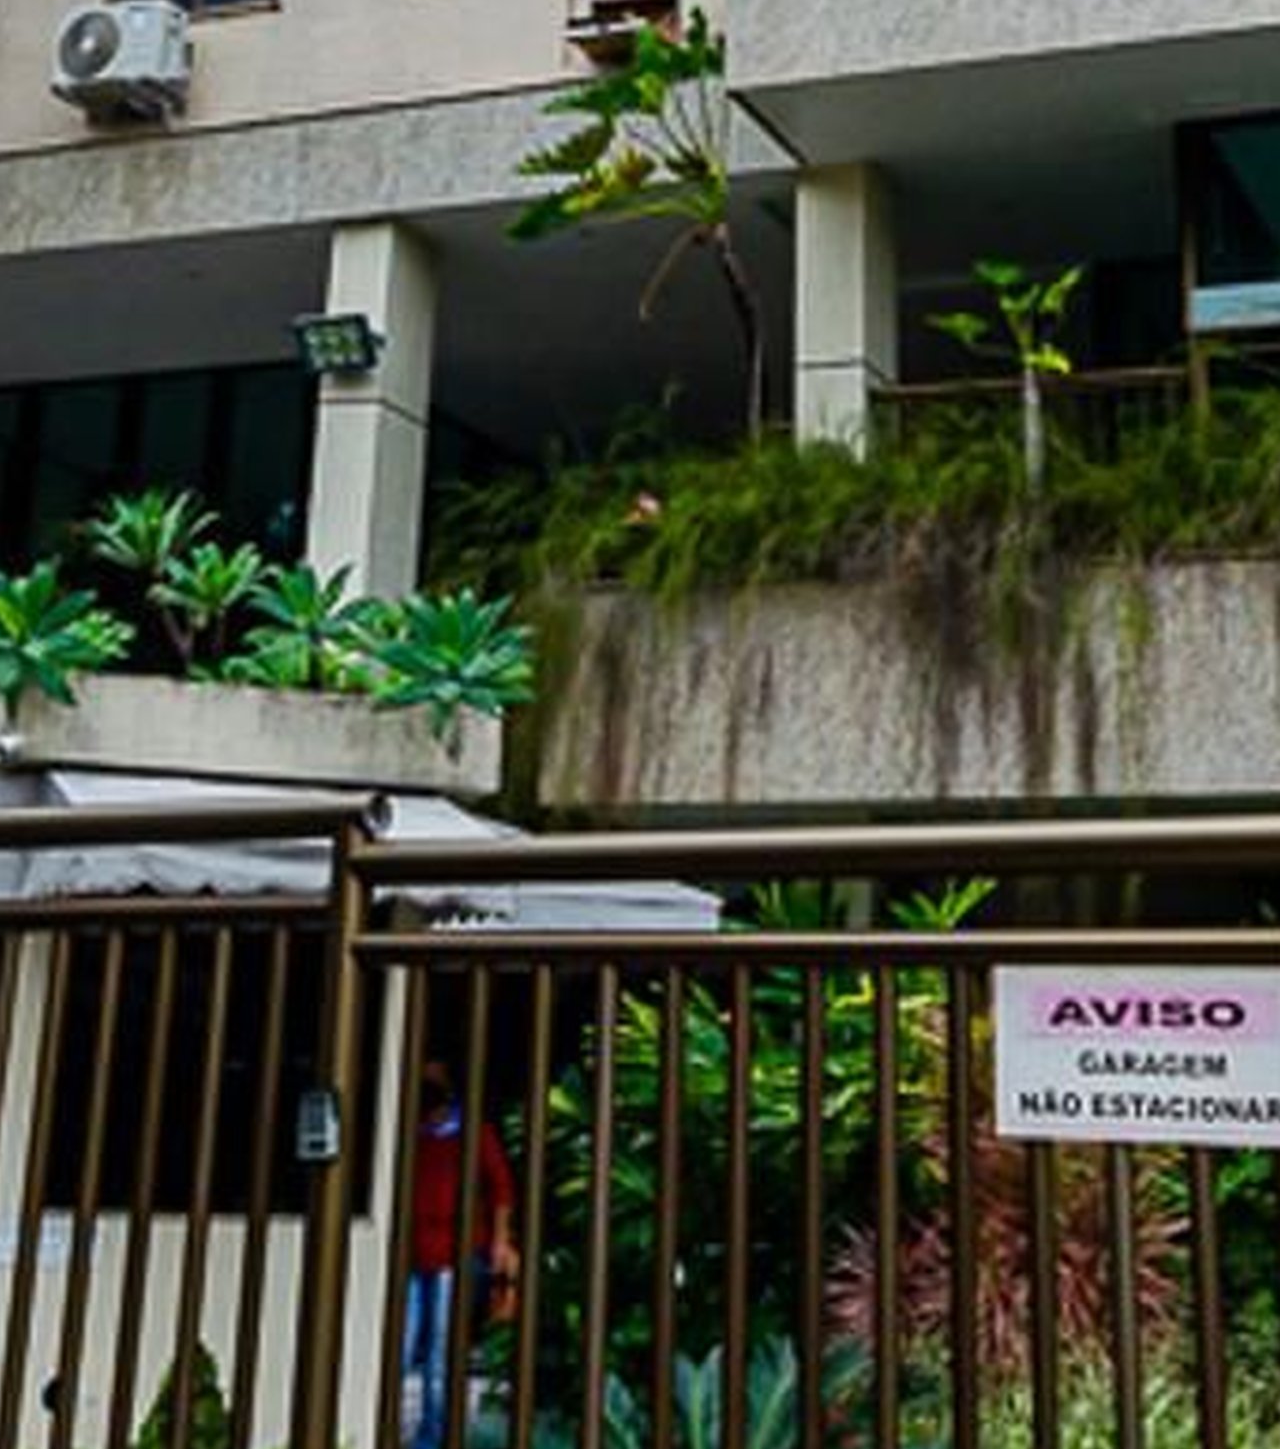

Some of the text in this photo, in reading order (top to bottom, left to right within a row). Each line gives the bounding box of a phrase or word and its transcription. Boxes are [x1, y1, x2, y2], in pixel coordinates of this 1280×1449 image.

[1048, 998, 1246, 1029] AVISO
[1078, 1049, 1228, 1078] GARAGEM
[1019, 1089, 1082, 1118] NÃO
